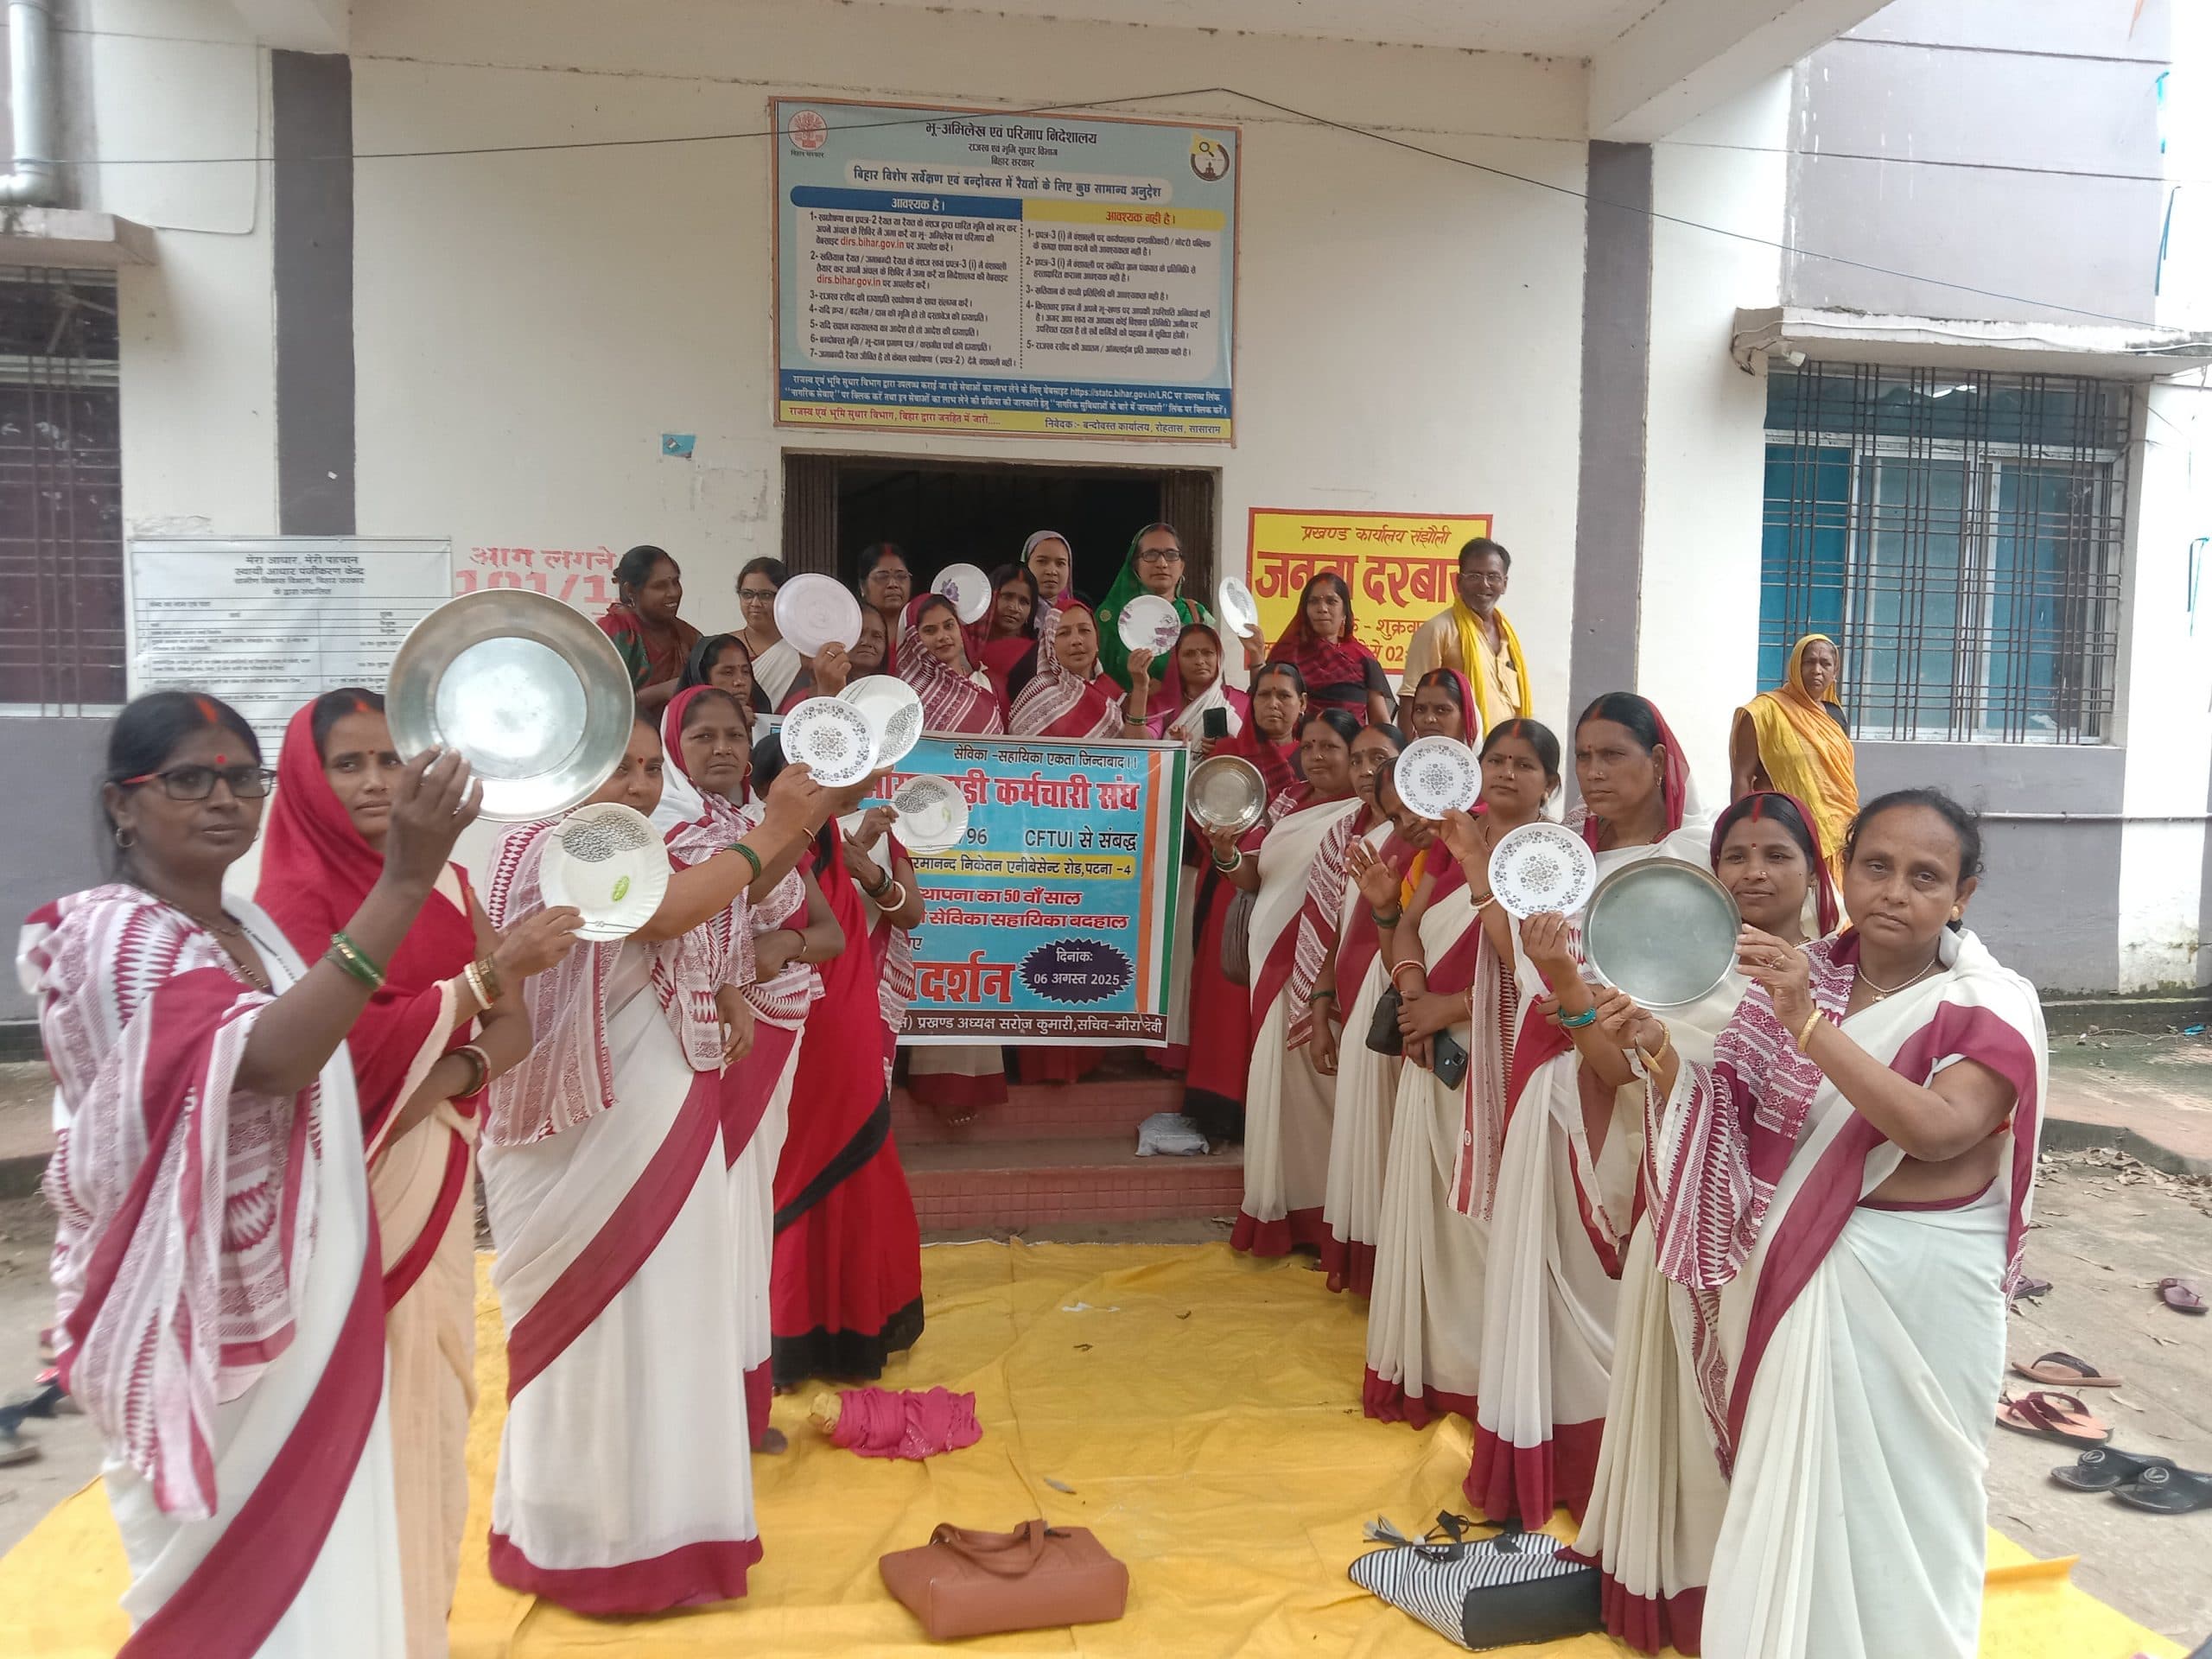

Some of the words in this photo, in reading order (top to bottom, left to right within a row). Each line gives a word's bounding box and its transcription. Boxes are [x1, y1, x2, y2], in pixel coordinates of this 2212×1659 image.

[925, 120, 986, 137] भू-अभिलेख
[989, 124, 1002, 137] एवं
[1006, 124, 1043, 140] परिमाप
[1046, 127, 1097, 143] निदेशालय
[969, 143, 989, 152] राजस्व
[1018, 146, 1036, 156] सुधार
[991, 155, 1009, 166] बिहार
[1011, 158, 1034, 168] सरकार
[854, 165, 879, 181] बिहार
[882, 167, 907, 181] विशेष
[911, 169, 944, 184] सर्वेक्षण
[946, 175, 960, 186] एवं
[963, 173, 1002, 188] बन्दोबस्त
[1015, 175, 1038, 189] रैयतों
[1042, 177, 1051, 190] के
[1054, 177, 1072, 193] लिए
[1076, 183, 1090, 197] कुछ
[1094, 184, 1128, 195] सामान्य
[1131, 183, 1161, 200] अनुदेश
[891, 198, 930, 210] आवश्यक
[1106, 212, 1142, 222] आवश्यक
[841, 238, 905, 250] dirs.bihar.gov.in
[817, 275, 881, 287] dirs.bihar.gov.in
[789, 407, 813, 416] राजस्व
[815, 408, 827, 418] एवं
[830, 407, 846, 420] भूमि
[847, 410, 868, 421] सुधार
[899, 410, 919, 422] बिहार
[920, 413, 936, 423] द्वारा
[938, 411, 962, 423] जनहित
[1083, 419, 1116, 429] बन्दोबस्त
[1301, 525, 1351, 542] प्रखण्ड
[1356, 524, 1408, 546] कार्यालय
[470, 547, 536, 568] आग
[540, 545, 619, 571] लगने
[954, 744, 988, 761] सेविका
[1046, 752, 1077, 766] एकता
[994, 772, 1092, 809] कर्मचारी
[1096, 775, 1141, 810] संघ
[1025, 830, 1073, 849] CFTUI
[1078, 825, 1094, 849] से
[1098, 827, 1138, 851] संबद्ध
[910, 856, 957, 872] रमानन्द
[960, 854, 1003, 873] निकेतन
[1006, 856, 1060, 875] एनीबेसेन्ट
[976, 890, 1003, 903] का
[1004, 889, 1020, 903] 50
[1023, 887, 1045, 904] वाँ
[1043, 892, 1083, 906] साल
[929, 907, 989, 925] सेविका
[990, 910, 1068, 928] सहायिका
[1069, 914, 1130, 929] बदहाल
[1033, 973, 1049, 984] 06
[1051, 972, 1088, 985] अगस्त
[1090, 974, 1121, 986] 2025
[917, 1017, 955, 1030] प्रखण्ड
[957, 1016, 996, 1030] अध्यक्ष
[999, 1014, 1033, 1031] सरोज
[1144, 1016, 1163, 1033] देवी
